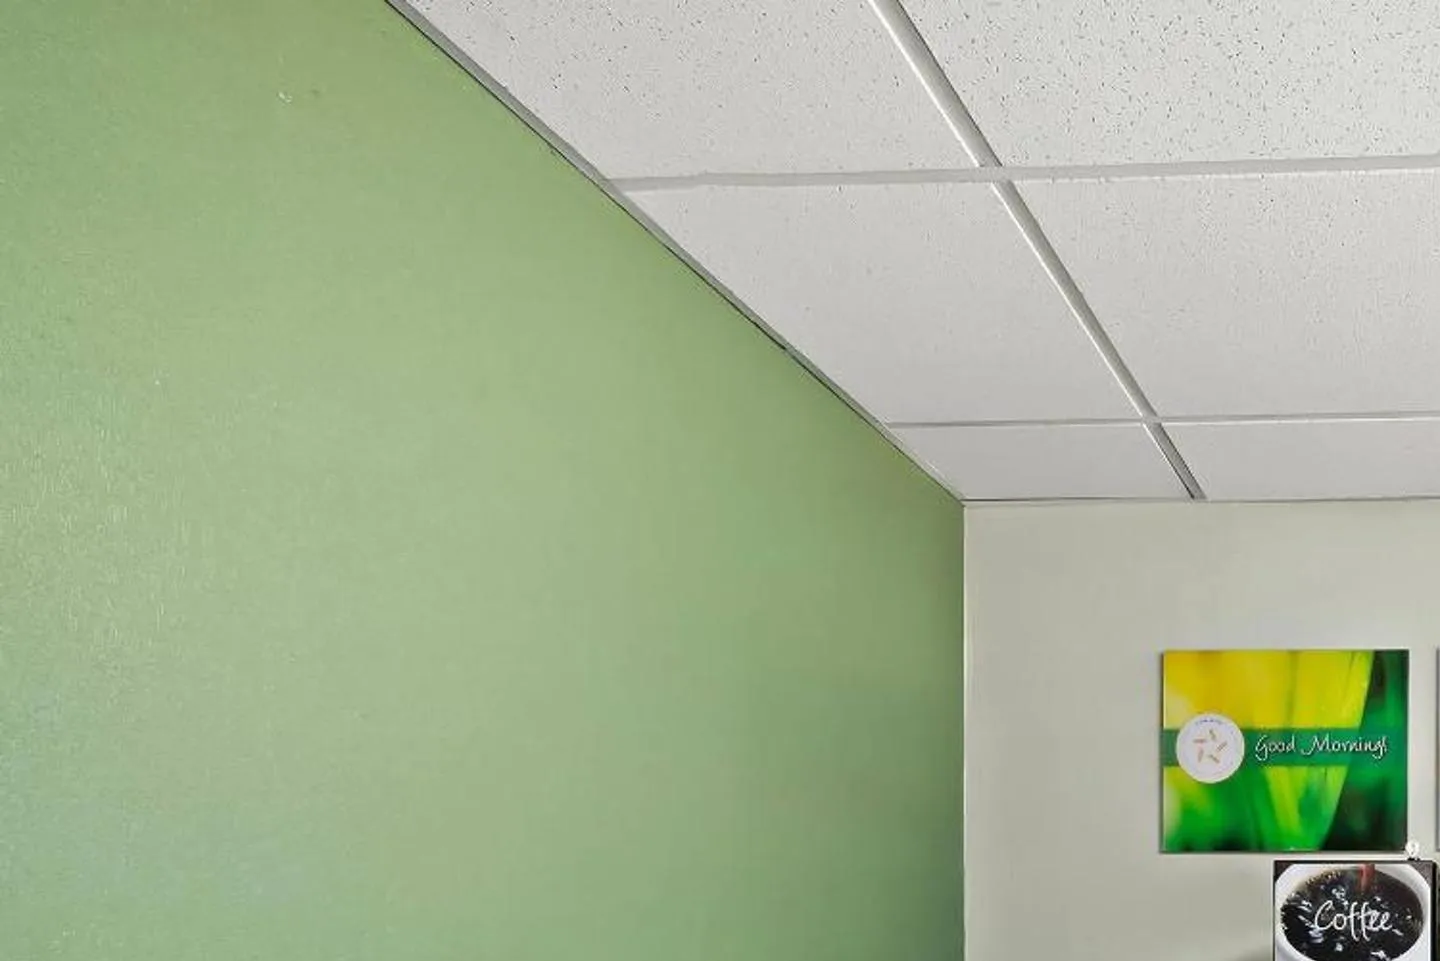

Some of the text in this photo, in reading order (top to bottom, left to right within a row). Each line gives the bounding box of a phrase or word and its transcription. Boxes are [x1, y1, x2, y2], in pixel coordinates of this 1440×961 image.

[1255, 734, 1387, 761] Good Morning!
[1315, 900, 1393, 942] Coffee
